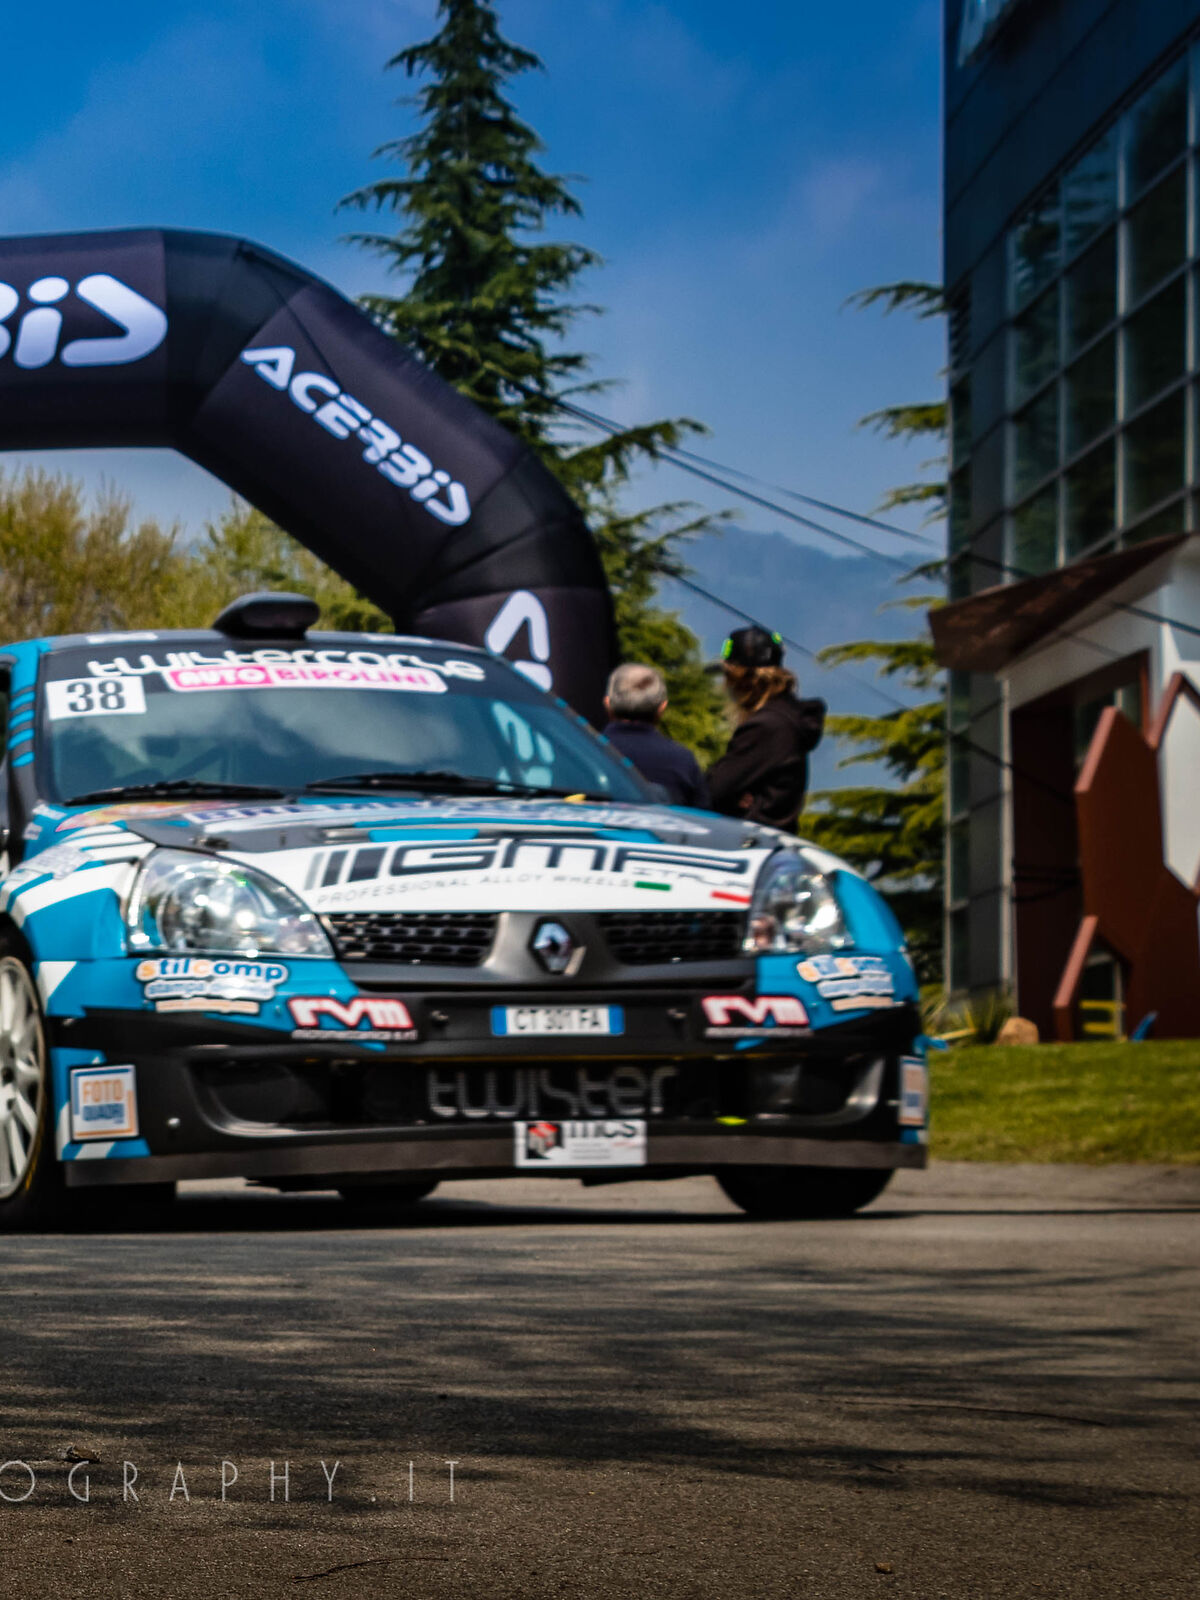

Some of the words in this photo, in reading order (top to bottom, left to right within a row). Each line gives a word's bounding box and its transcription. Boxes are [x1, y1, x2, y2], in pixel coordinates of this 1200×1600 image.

[240, 345, 472, 526] ACERBIS
[179, 666, 267, 687] AUTO
[65, 679, 127, 713] 38
[316, 877, 469, 906] PROFESSIONAL
[474, 872, 546, 889] ALLOY
[553, 872, 632, 888] WHEELS
[140, 958, 284, 981] stilcomp
[82, 1079, 124, 1104] FOTO
